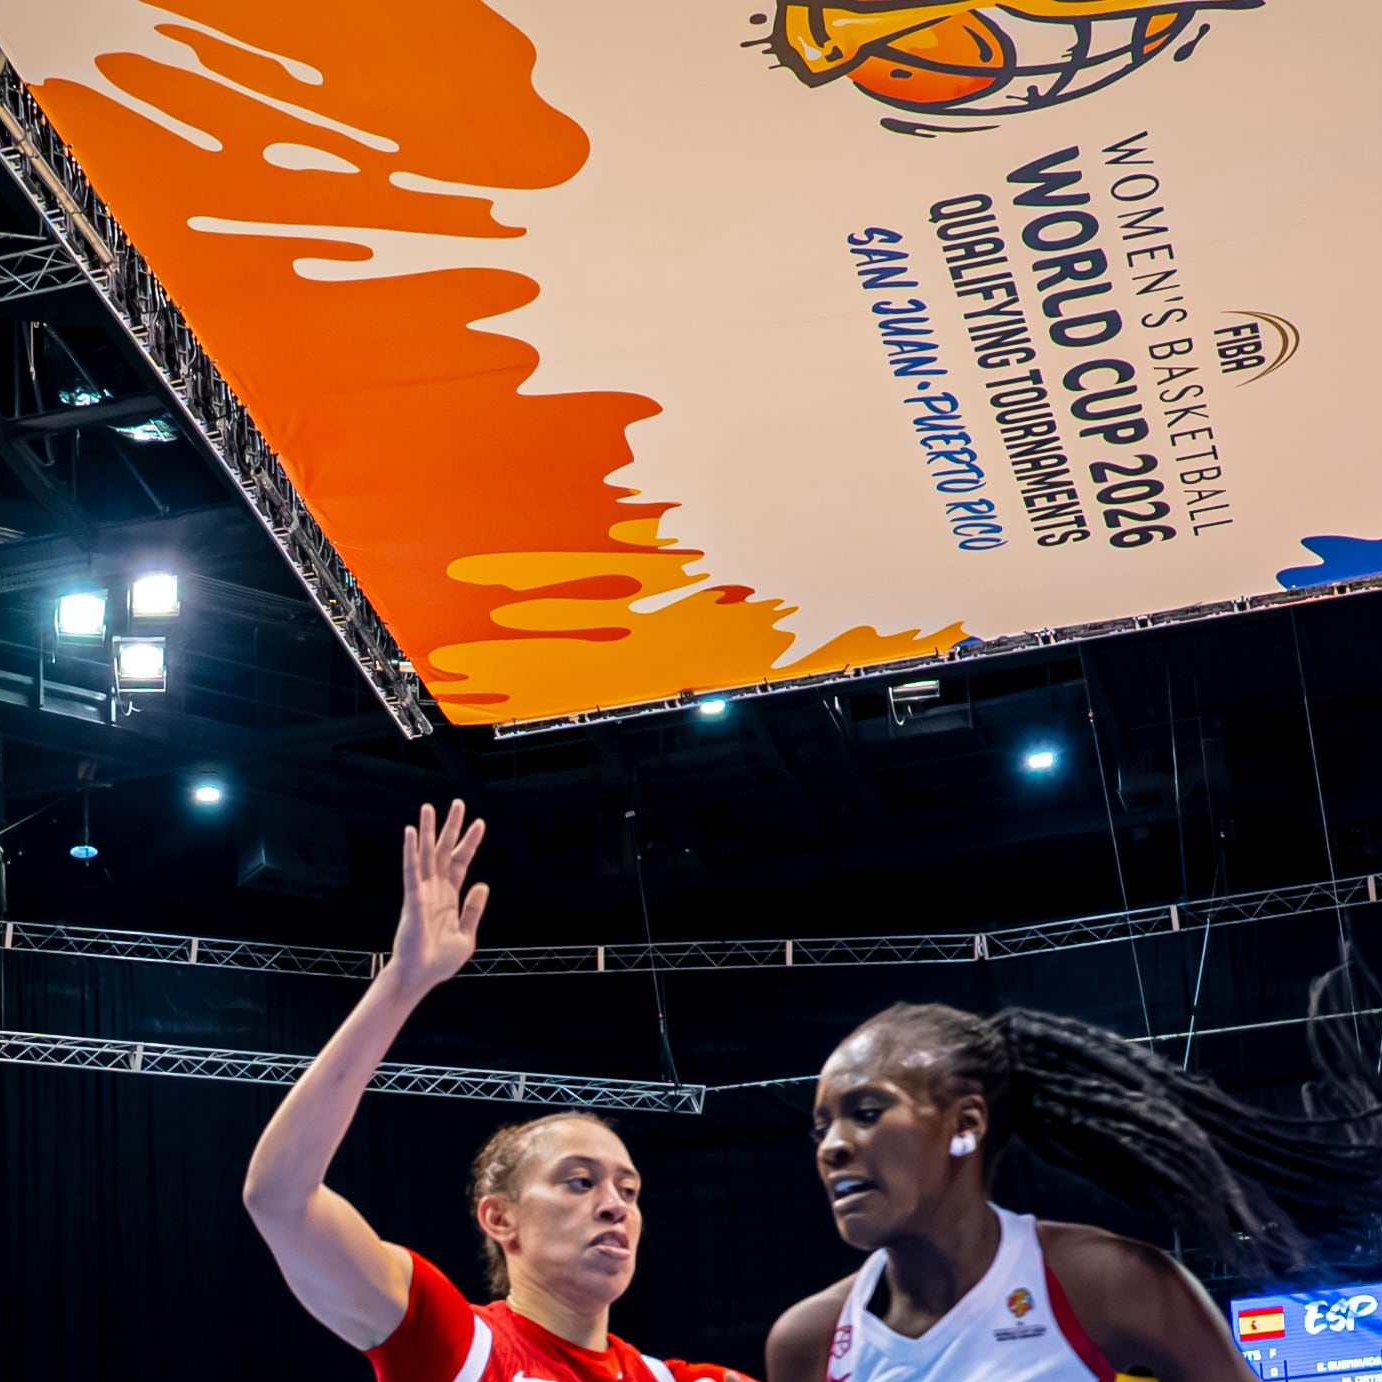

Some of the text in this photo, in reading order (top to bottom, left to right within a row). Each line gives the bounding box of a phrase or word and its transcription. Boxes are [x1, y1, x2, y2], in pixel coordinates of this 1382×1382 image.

[847, 226, 919, 290] SAN
[944, 496, 1009, 551] RICO
[928, 192, 1092, 548] QUALIFYING TOURNAMENTS
[1006, 145, 1177, 549] WORLD CUP 2026
[1102, 130, 1234, 537] WOMEN'S BASKETBALL
[1213, 321, 1266, 375] FIBA
[1304, 1294, 1379, 1335] ESP
